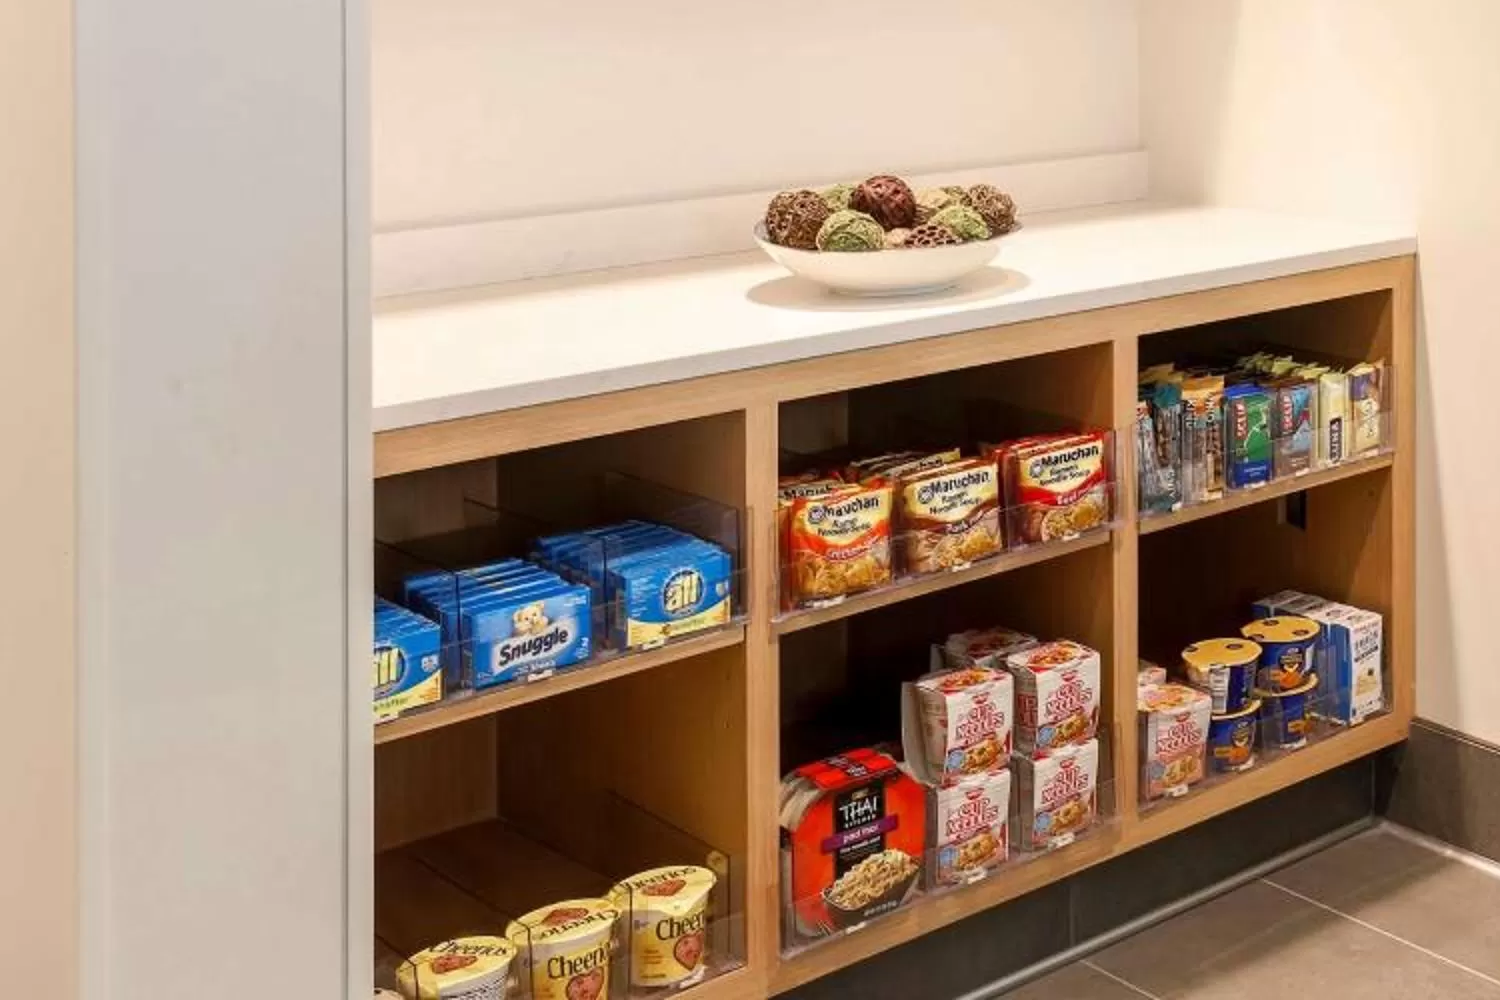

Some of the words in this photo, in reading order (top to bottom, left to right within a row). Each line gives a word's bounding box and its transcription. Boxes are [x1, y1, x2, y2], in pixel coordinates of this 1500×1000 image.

[1040, 443, 1100, 468] Maruchan
[930, 469, 991, 495] Maruchan
[663, 572, 699, 614] all
[498, 623, 569, 667] Snuggle
[374, 647, 401, 688] ll
[838, 795, 878, 821] THAI
[655, 908, 705, 942] Cheer
